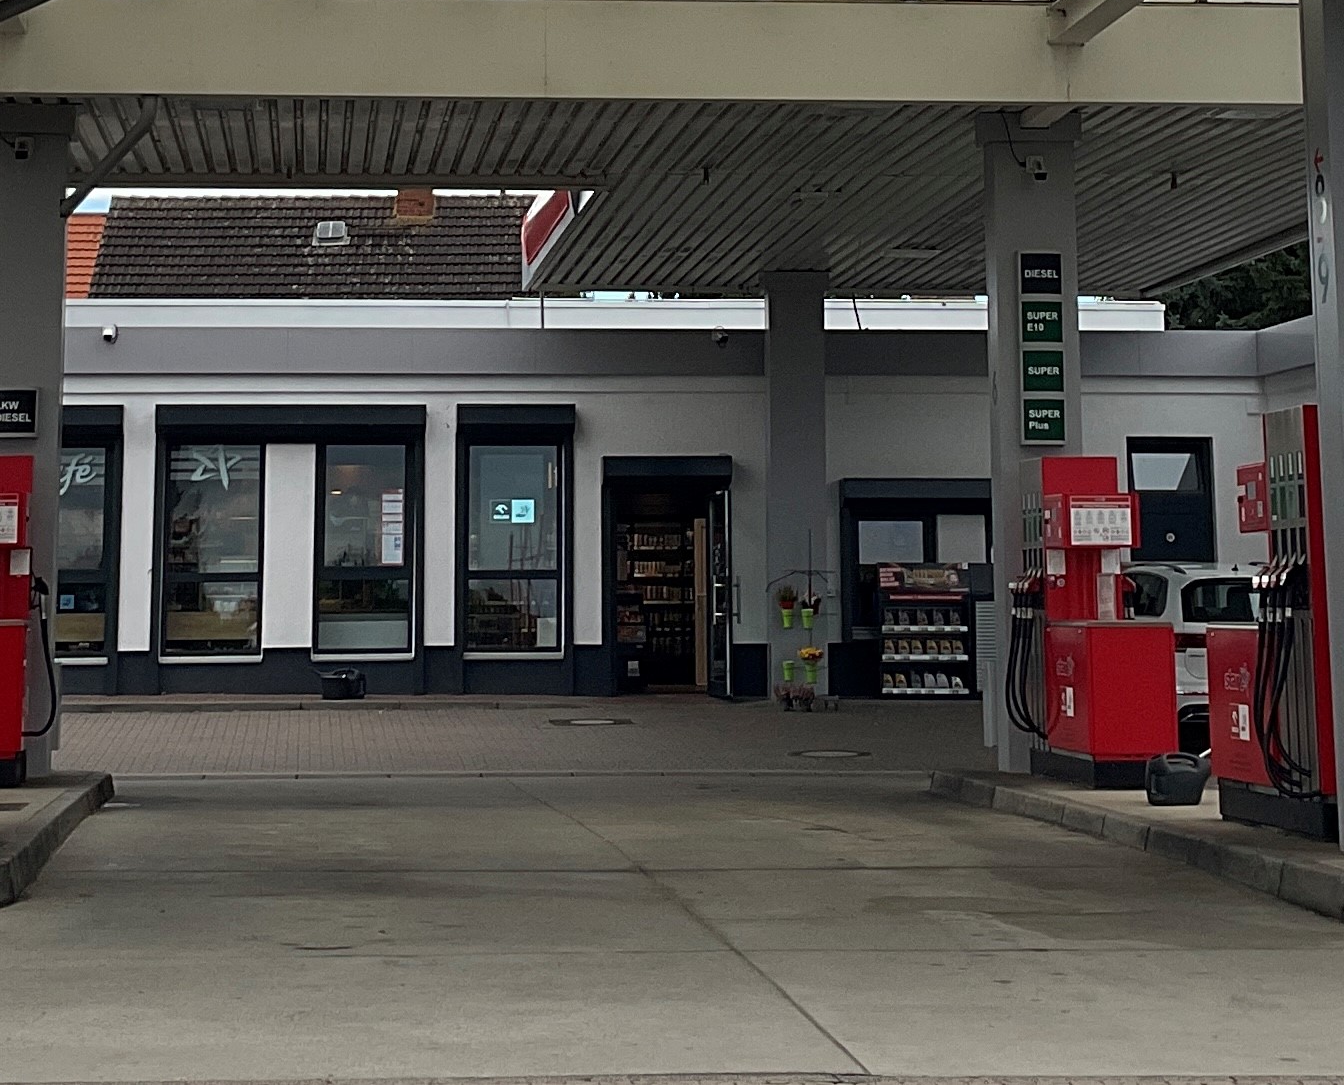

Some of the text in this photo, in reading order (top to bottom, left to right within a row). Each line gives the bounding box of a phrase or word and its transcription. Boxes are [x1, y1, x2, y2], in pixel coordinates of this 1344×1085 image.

[1024, 269, 1059, 279] DIESEL
[1026, 311, 1059, 321] SUPER
[1026, 322, 1045, 332] E10
[1027, 366, 1060, 376] SUPER
[1028, 409, 1061, 419] SUPER
[1028, 420, 1050, 430] Plus
